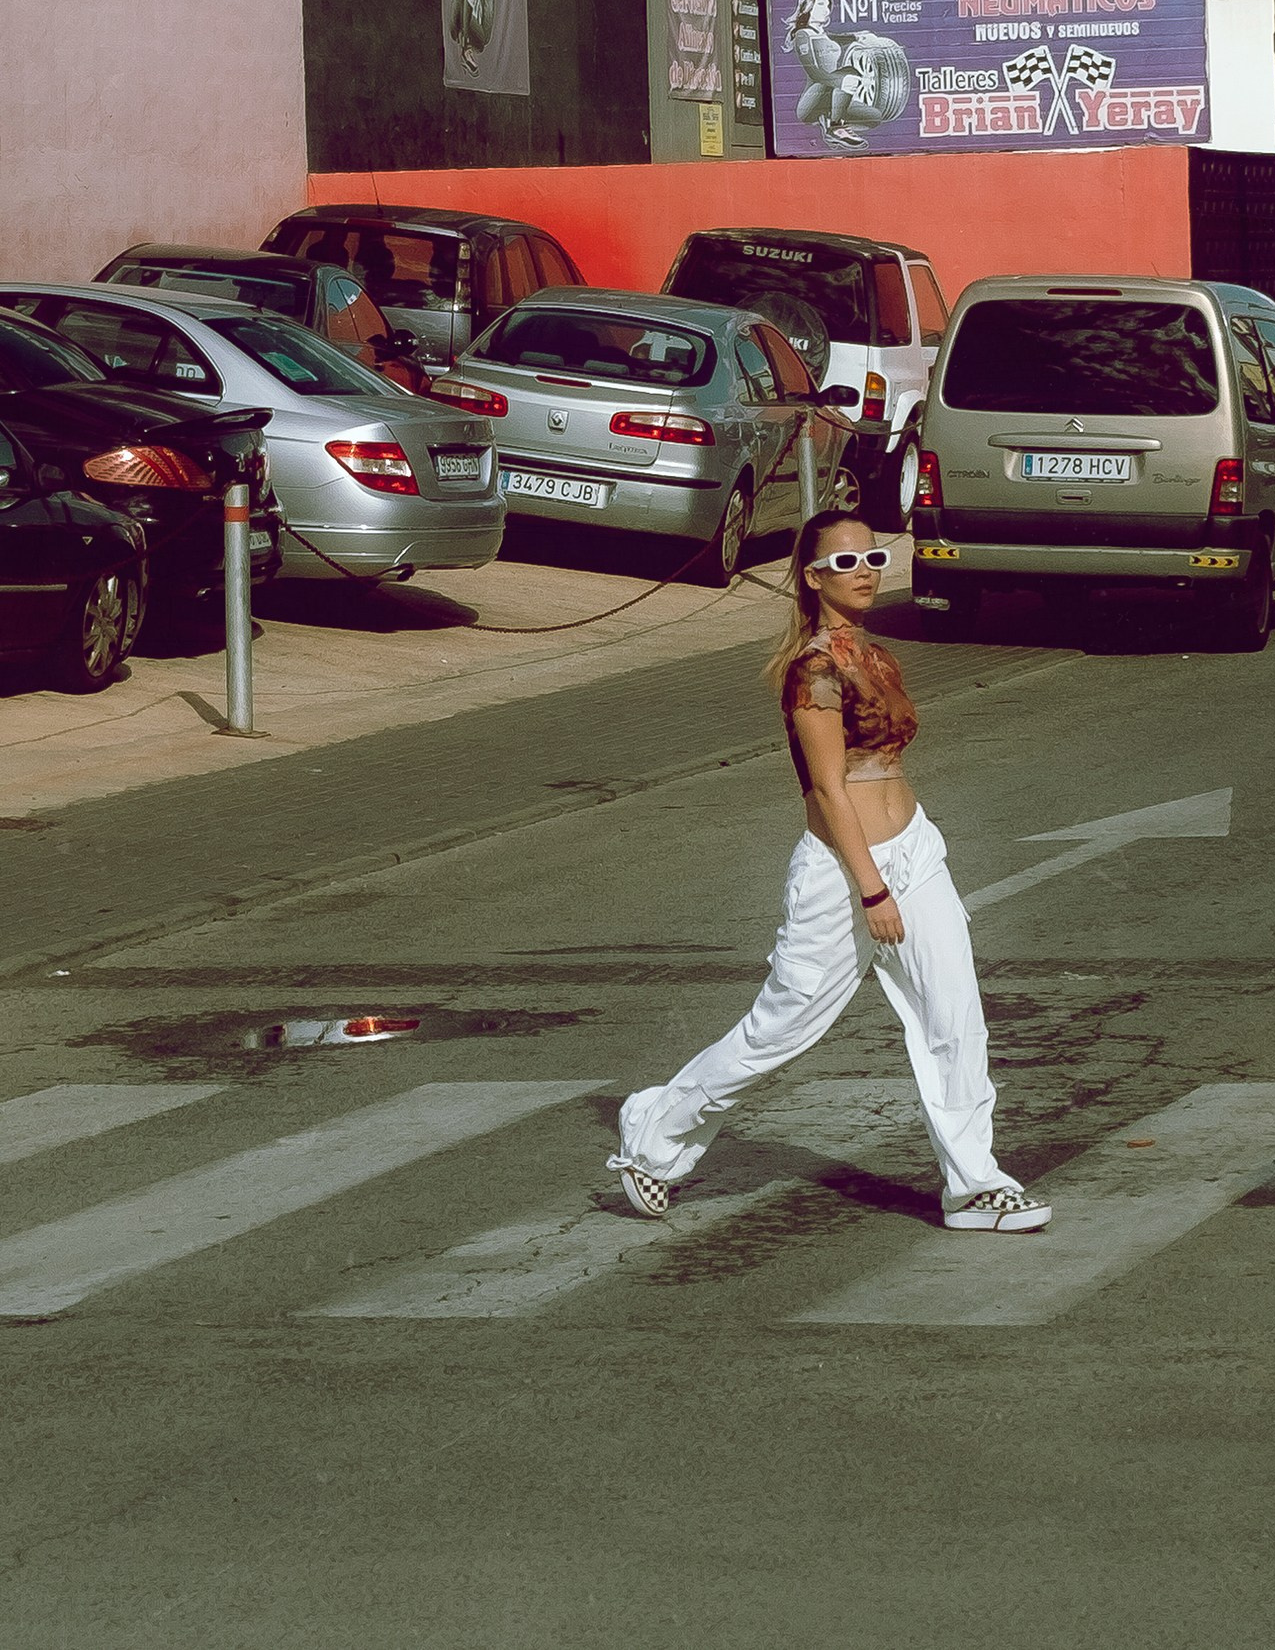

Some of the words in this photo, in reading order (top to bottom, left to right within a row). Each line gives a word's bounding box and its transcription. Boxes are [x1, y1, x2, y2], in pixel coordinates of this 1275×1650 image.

[881, 0, 922, 13] Precios
[975, 22, 1041, 42] NUEVOS
[1057, 22, 1140, 38] SEMINUEVOS
[915, 67, 999, 92] Talleres
[920, 93, 1042, 137] Brian
[1076, 86, 1205, 135] Yeray
[742, 245, 813, 263] SUZUKI
[1038, 457, 1083, 475] 1278
[1089, 458, 1126, 476] HCV
[512, 473, 556, 495] 3479
[560, 479, 594, 501] CJB
